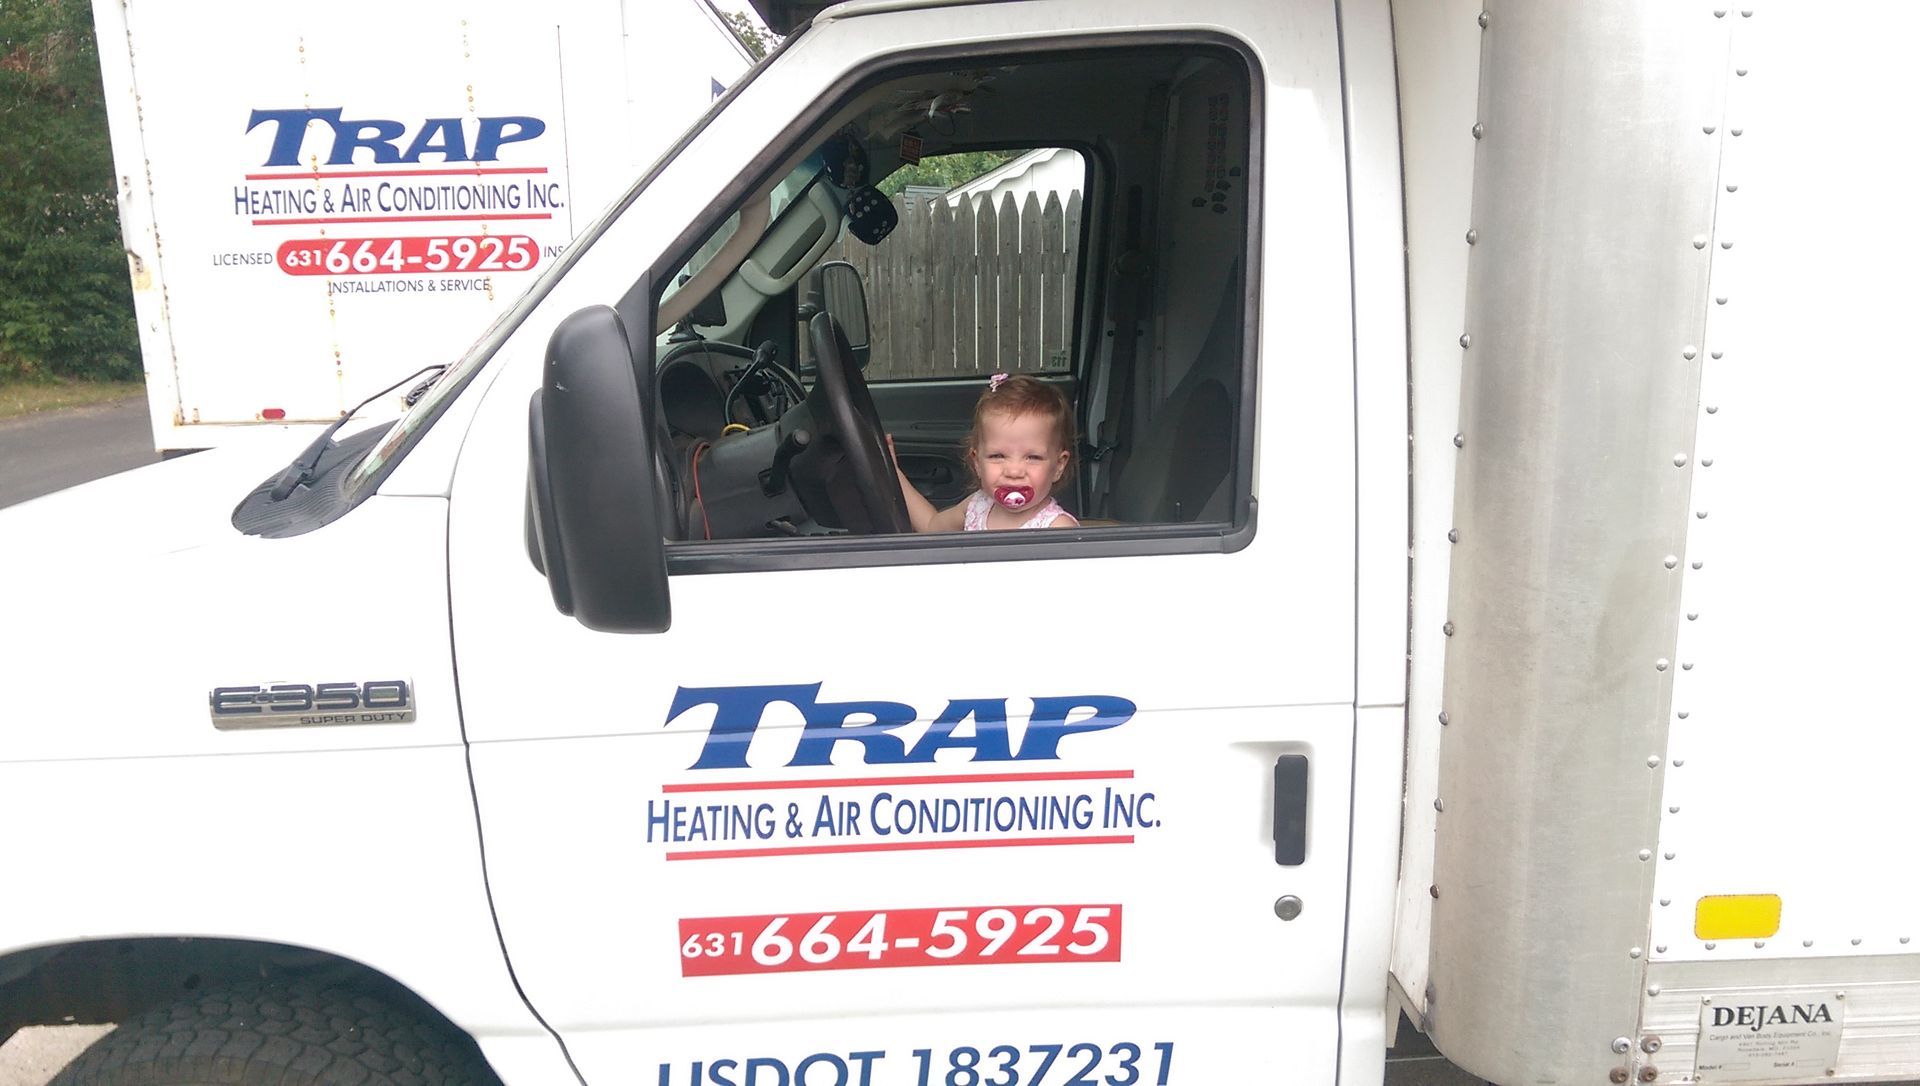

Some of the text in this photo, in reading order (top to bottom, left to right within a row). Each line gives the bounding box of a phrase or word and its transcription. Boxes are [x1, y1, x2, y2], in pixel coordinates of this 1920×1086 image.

[246, 107, 546, 167] TRAP
[234, 179, 565, 216] HEATING & AIR CONDITIONING INC.
[213, 253, 273, 267] LICENSED
[328, 278, 488, 295] INSTALLATIONS & SERVICE
[213, 680, 407, 714] E-350
[300, 712, 407, 725] SUPER DUTY
[663, 680, 1137, 770] TRAP
[647, 786, 1162, 843] HEATING & AIR CONDITIONING INC.
[1711, 1003, 1833, 1032] DEJANA
[658, 1041, 1174, 1086] USDOT 1837231
